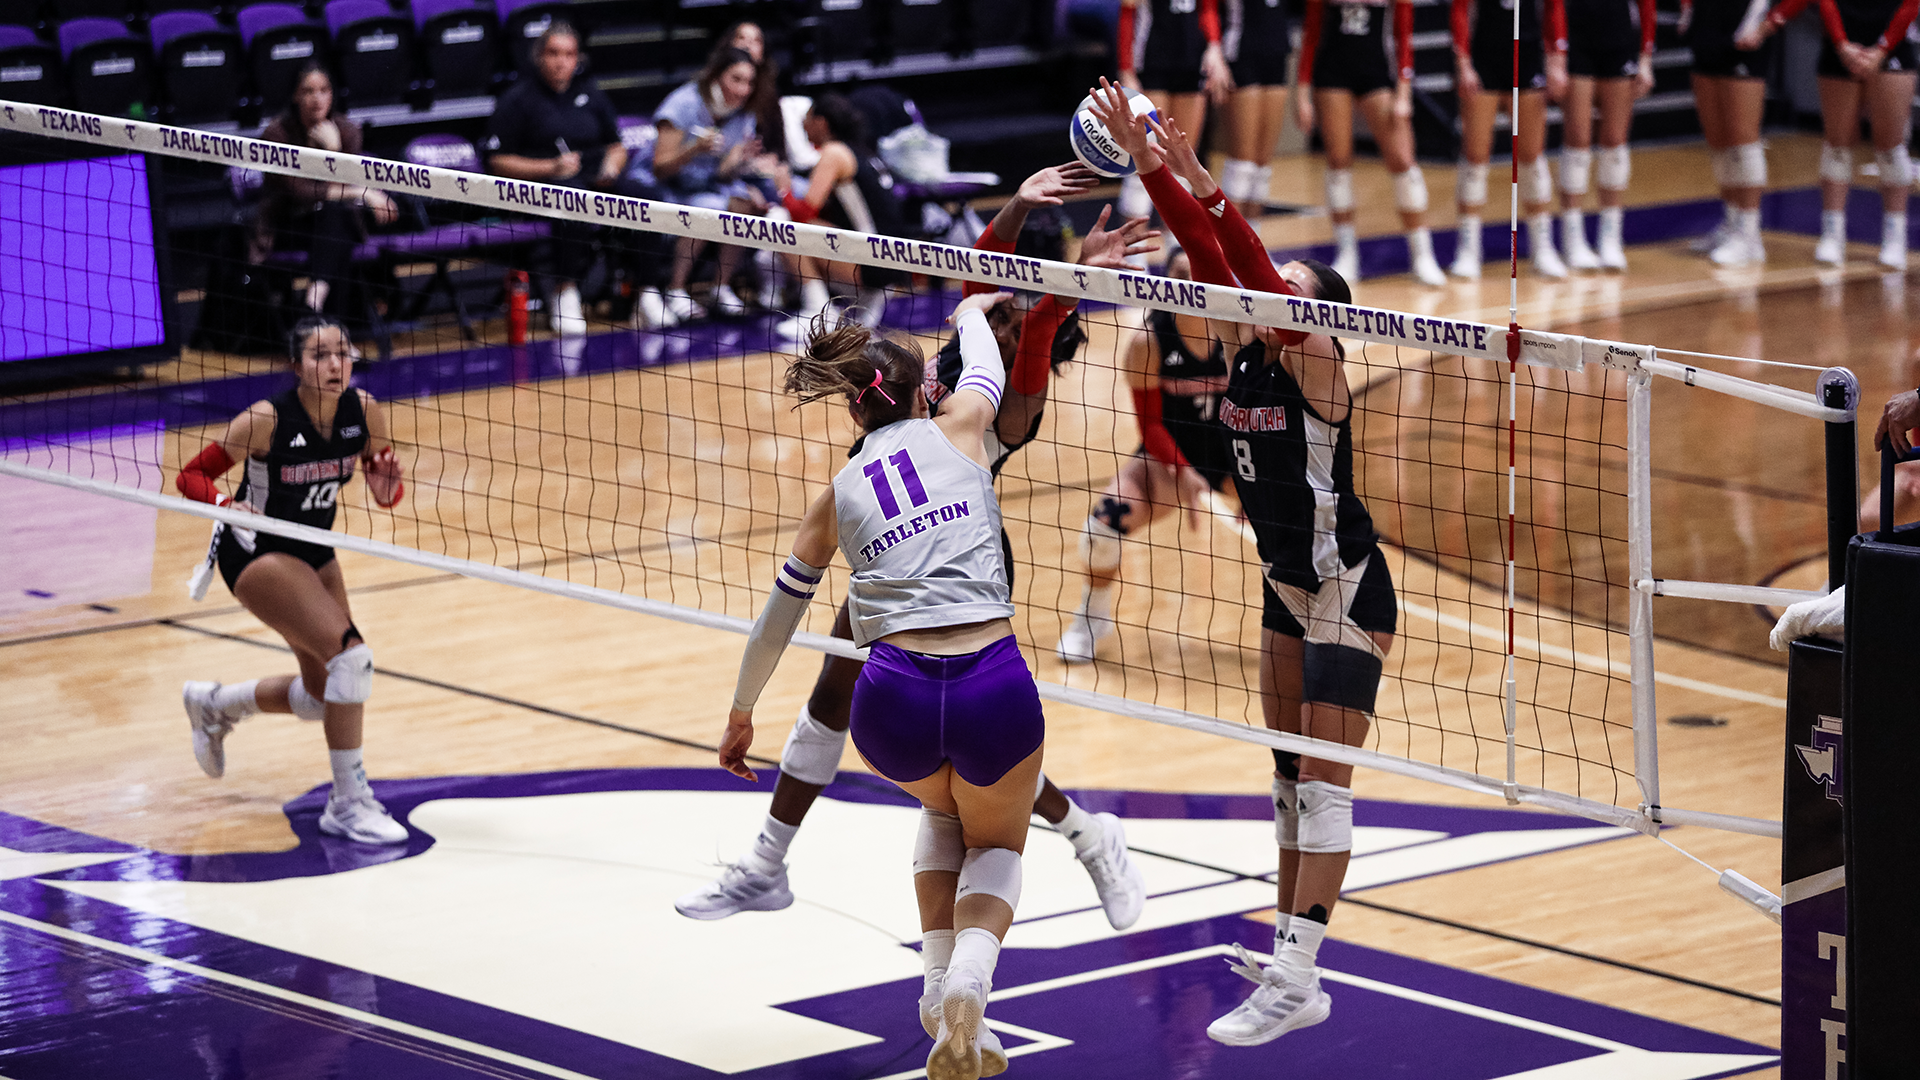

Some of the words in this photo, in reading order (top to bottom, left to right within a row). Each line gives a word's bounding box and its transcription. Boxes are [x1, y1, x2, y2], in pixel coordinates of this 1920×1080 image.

[1082, 119, 1121, 160] molten
[38, 108, 102, 136] TEXANS
[159, 127, 243, 160] TARLETON
[250, 142, 301, 169] STATE
[361, 159, 431, 189] TEXANS
[494, 179, 588, 214] TARLETON
[595, 196, 651, 223] STATE
[719, 213, 797, 246] TEXANS
[867, 236, 973, 274] TARLETON
[978, 253, 1043, 284] STATE
[1118, 273, 1207, 309] TEXANS
[1286, 298, 1405, 339] TARLETON
[1413, 317, 1487, 351] STATE
[1615, 347, 1638, 358] Senoh
[1250, 406, 1287, 431] UTAH
[1232, 438, 1256, 482] 8
[301, 481, 339, 511] 10
[862, 448, 930, 521] 11
[859, 500, 970, 563] TARLETON
